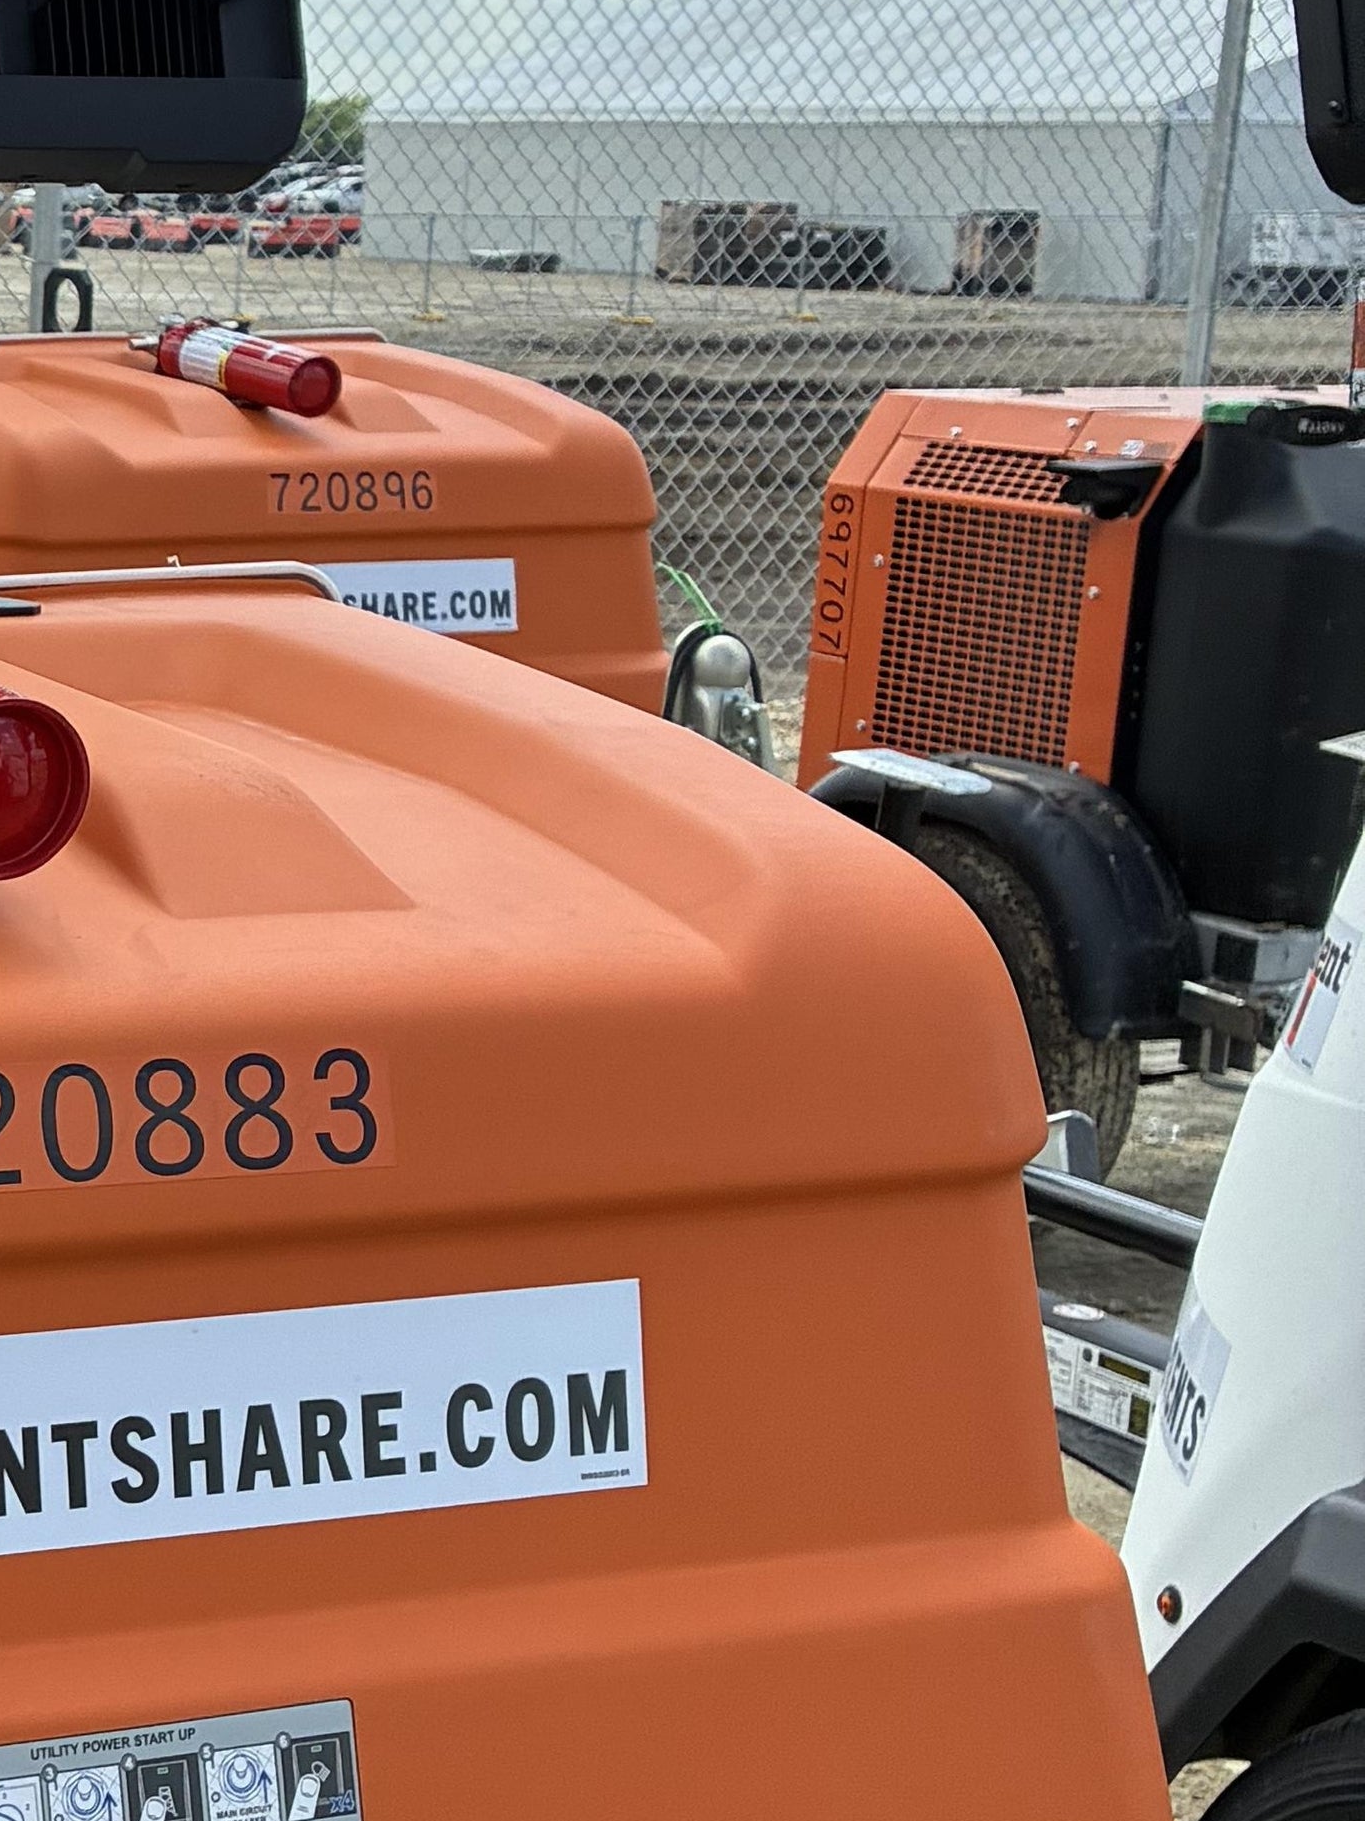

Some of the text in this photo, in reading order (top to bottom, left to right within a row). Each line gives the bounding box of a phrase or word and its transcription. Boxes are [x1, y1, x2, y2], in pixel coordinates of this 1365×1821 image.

[269, 470, 433, 512] 720896
[819, 493, 854, 650] 697707
[30, 1727, 196, 1761] UTILITY POWER START UP
